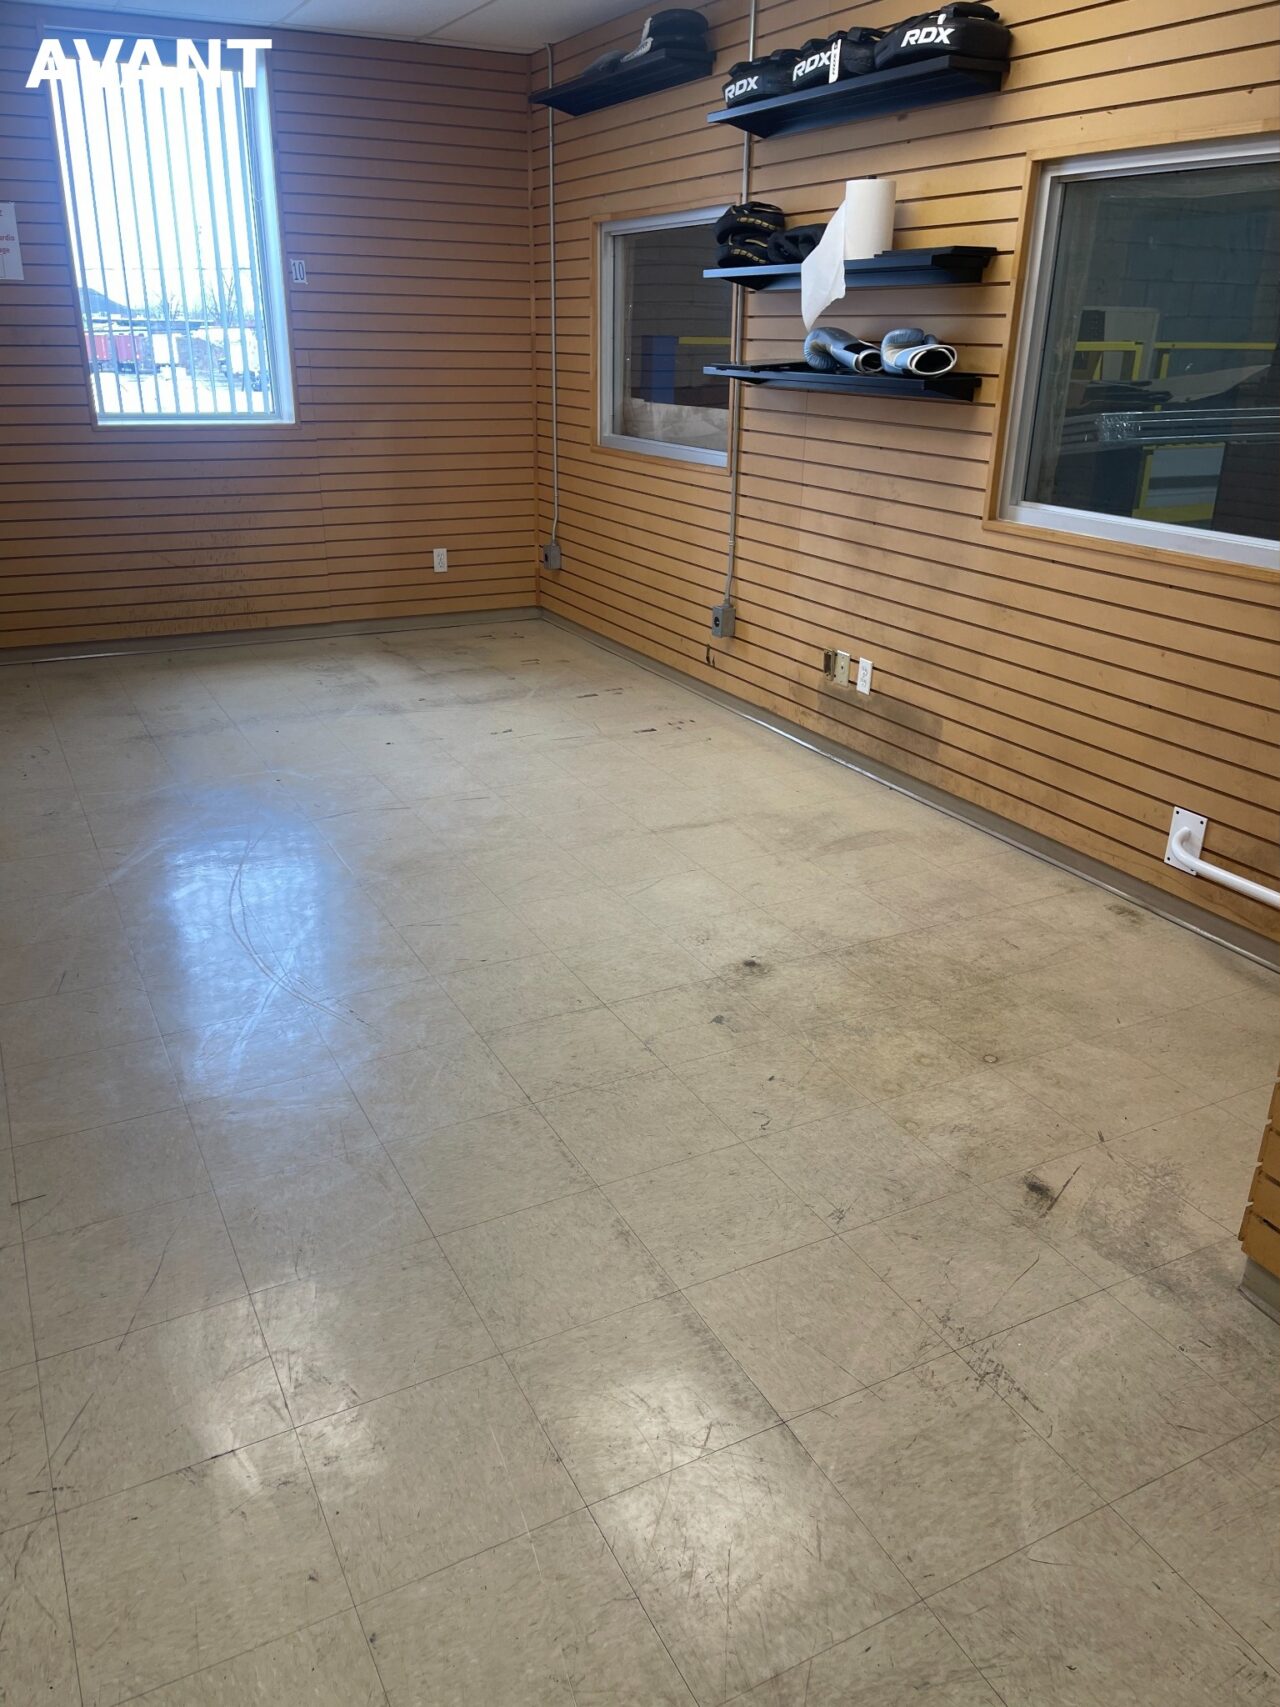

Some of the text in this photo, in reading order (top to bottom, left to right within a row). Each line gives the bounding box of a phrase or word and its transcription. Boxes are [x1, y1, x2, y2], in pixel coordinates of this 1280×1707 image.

[900, 26, 956, 48] RDX
[792, 50, 832, 82] RDX
[724, 75, 760, 103] RDX
[292, 261, 305, 281] 10
